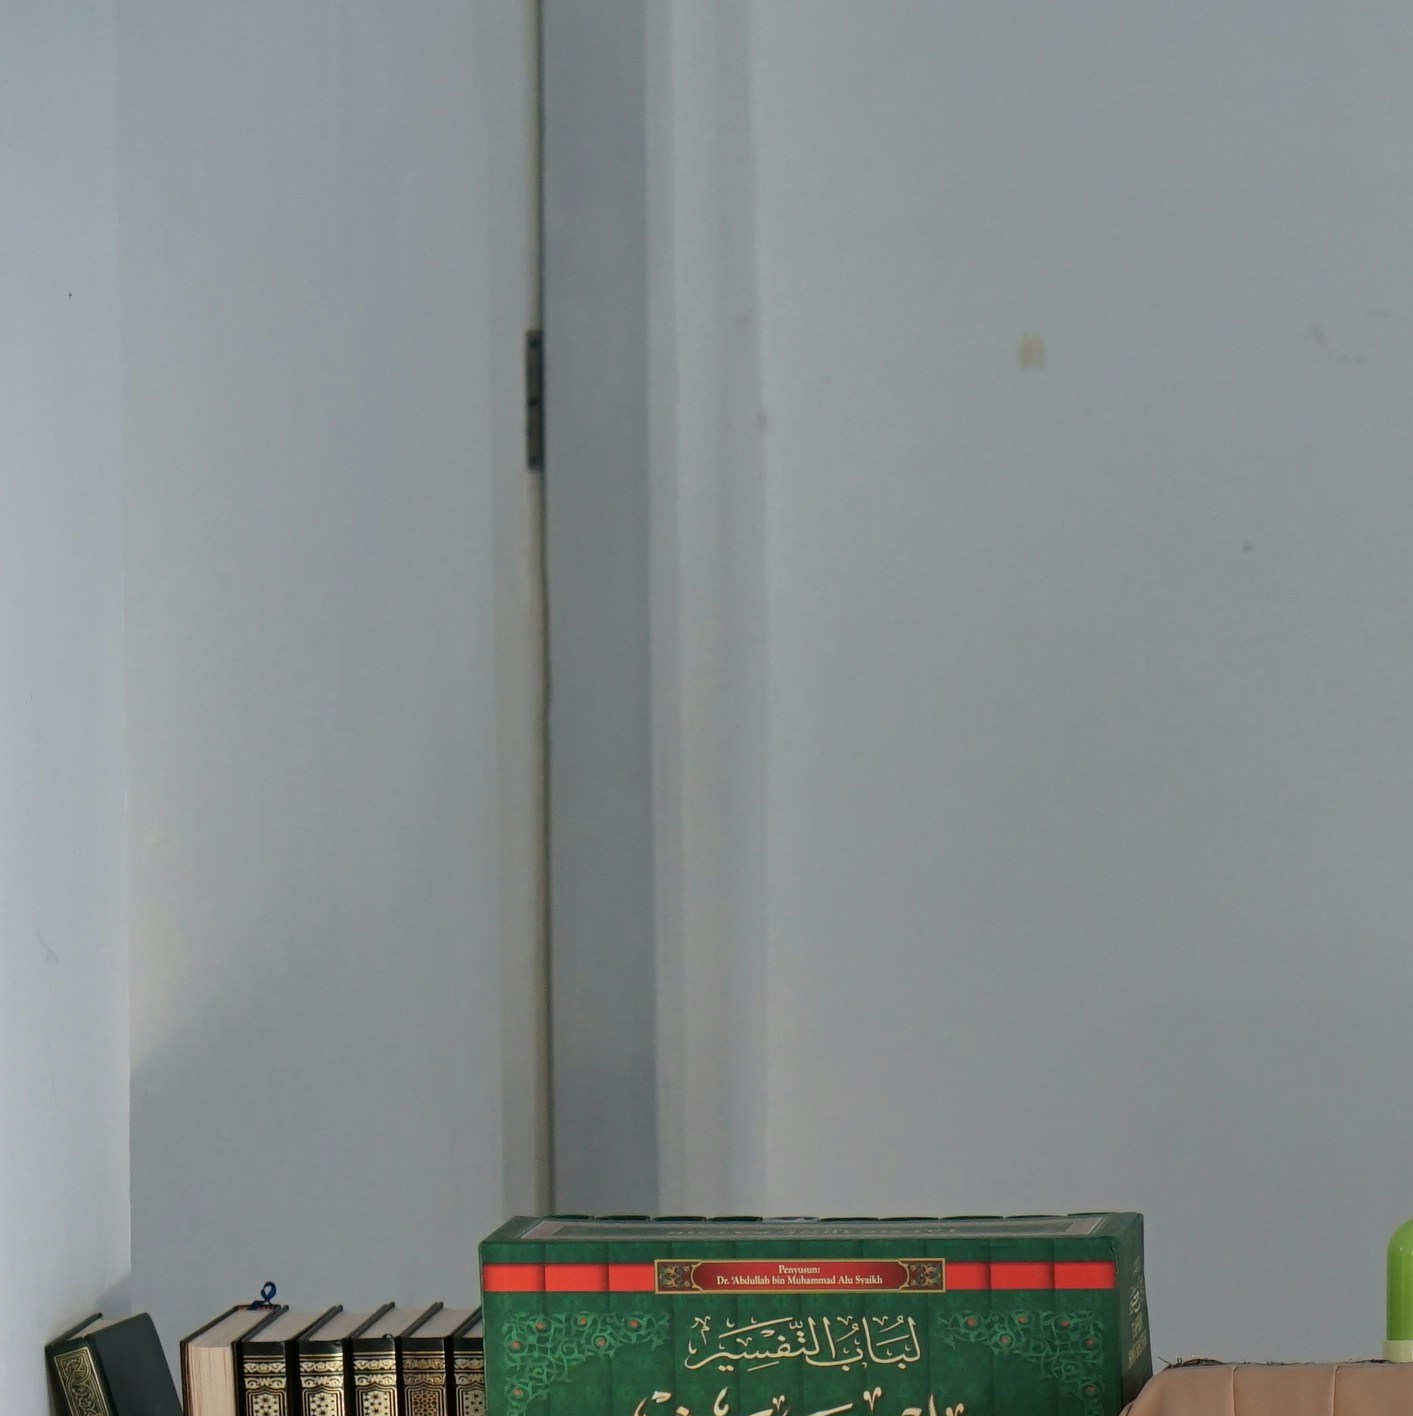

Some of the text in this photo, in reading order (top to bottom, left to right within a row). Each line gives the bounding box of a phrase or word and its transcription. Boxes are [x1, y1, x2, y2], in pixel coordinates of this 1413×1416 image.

[778, 1265, 821, 1277] Penyusun:
[717, 1276, 730, 1285] Dr.
[772, 1275, 786, 1284] bin
[788, 1275, 836, 1285] Muhammad
[838, 1275, 853, 1284] Alu
[855, 1275, 883, 1287] Syaikh
